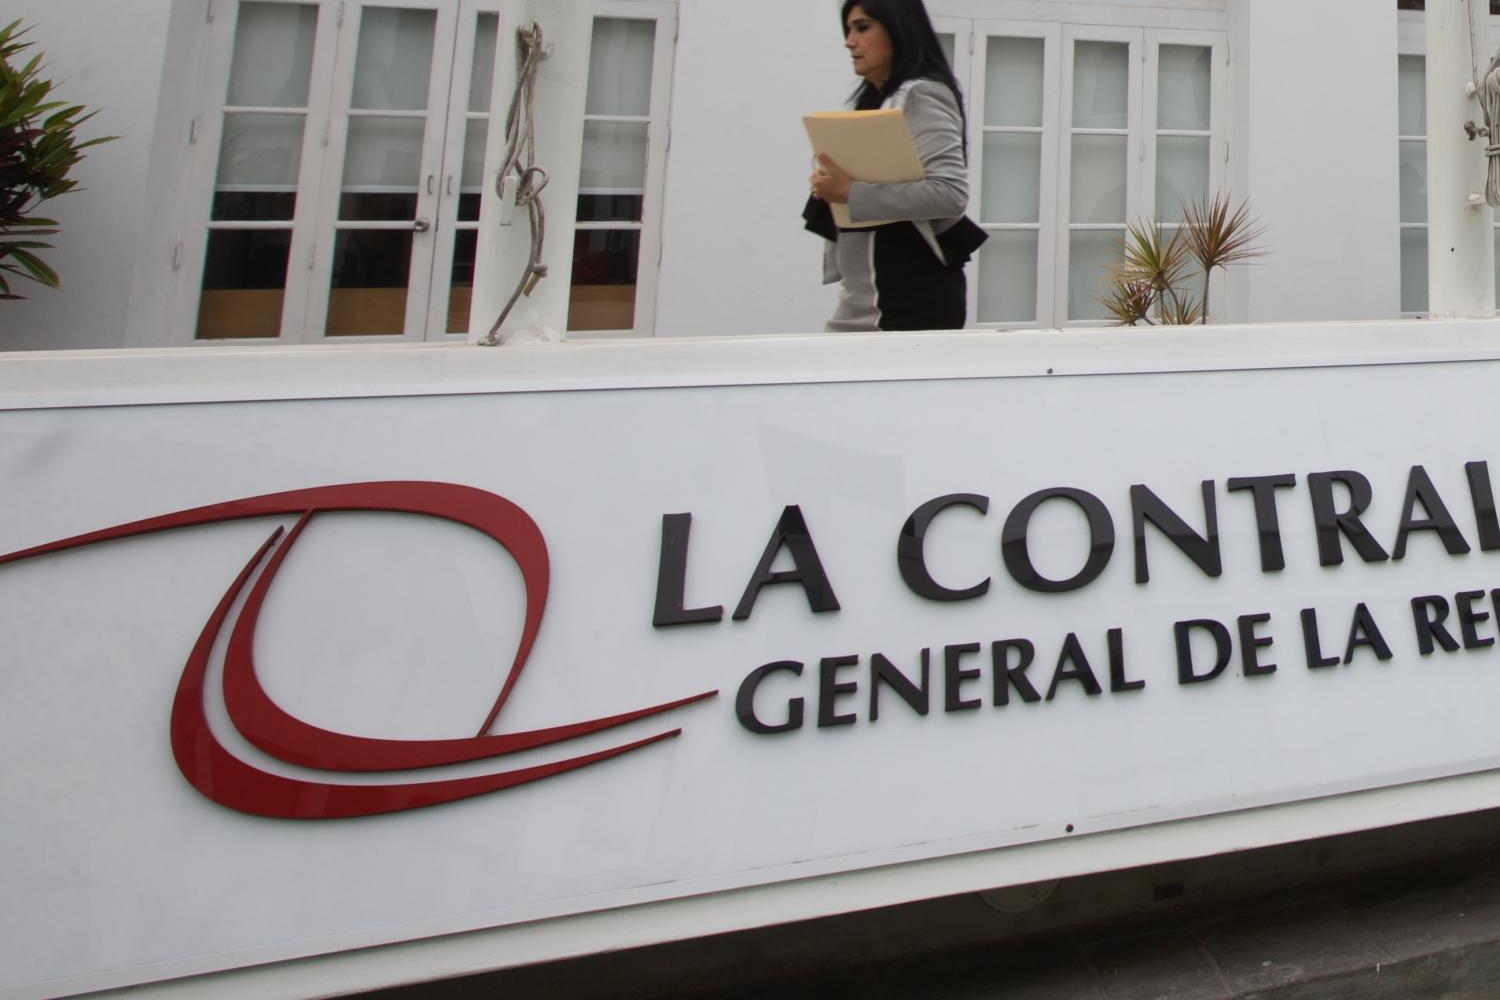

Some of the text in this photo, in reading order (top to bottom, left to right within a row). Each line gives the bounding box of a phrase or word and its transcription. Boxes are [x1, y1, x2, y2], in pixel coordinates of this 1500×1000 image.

[652, 504, 841, 628] LA
[735, 627, 1146, 736] GENERAL
[1173, 613, 1278, 685] DE
[1300, 602, 1393, 670] LA
